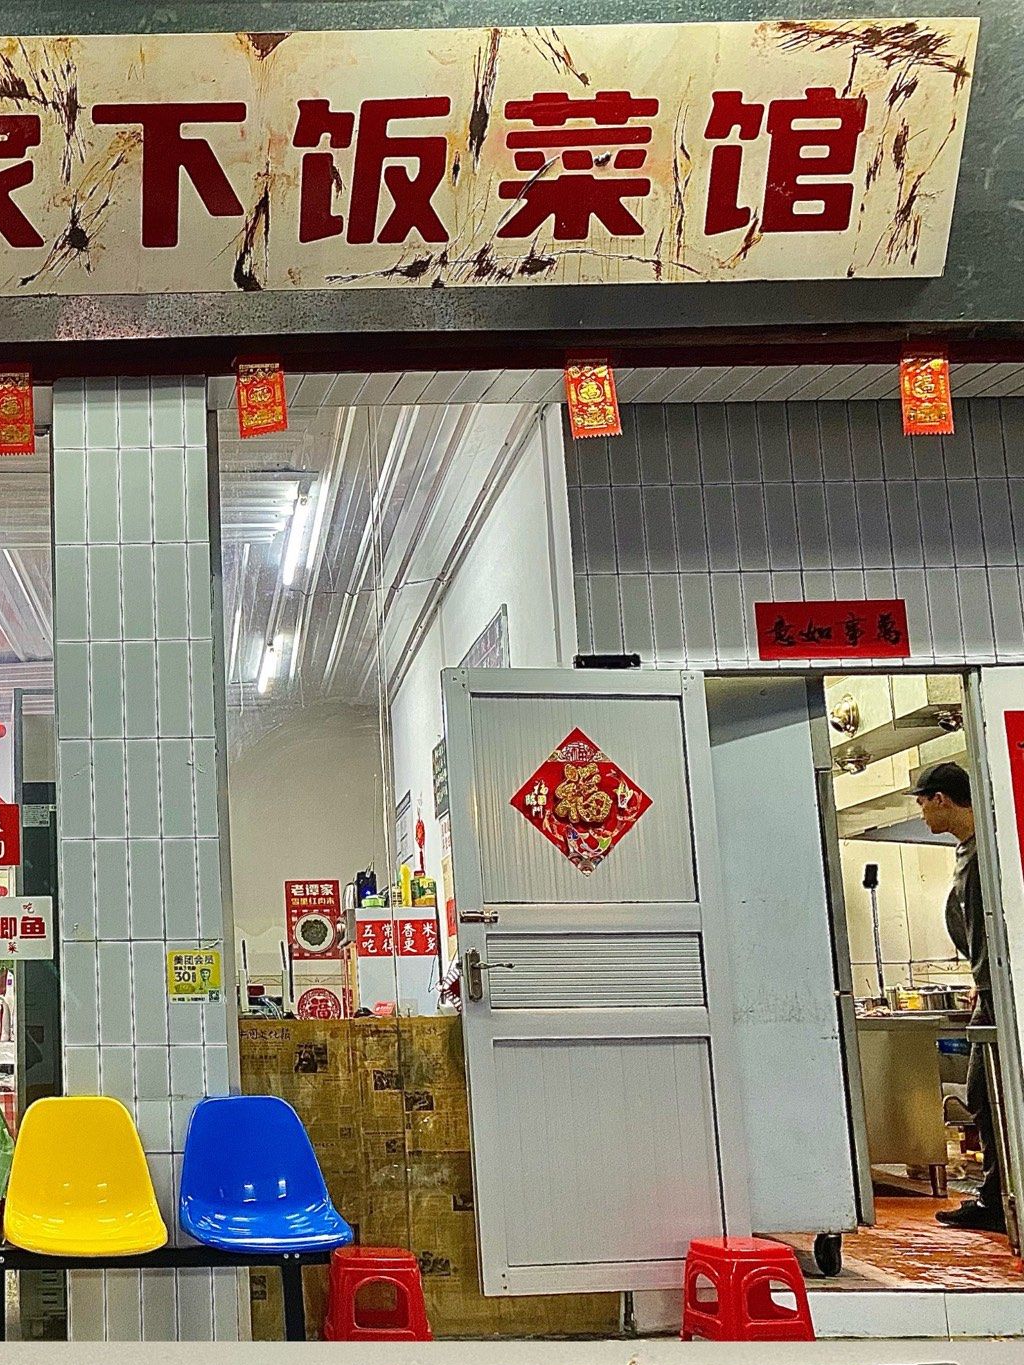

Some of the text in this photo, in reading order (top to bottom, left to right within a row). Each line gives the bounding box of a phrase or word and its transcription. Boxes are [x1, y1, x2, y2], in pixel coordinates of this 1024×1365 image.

[290, 884, 334, 896] 老谭家
[362, 924, 437, 937] 五常香米
[362, 938, 436, 953] 吃得更多
[174, 971, 191, 982] 30
